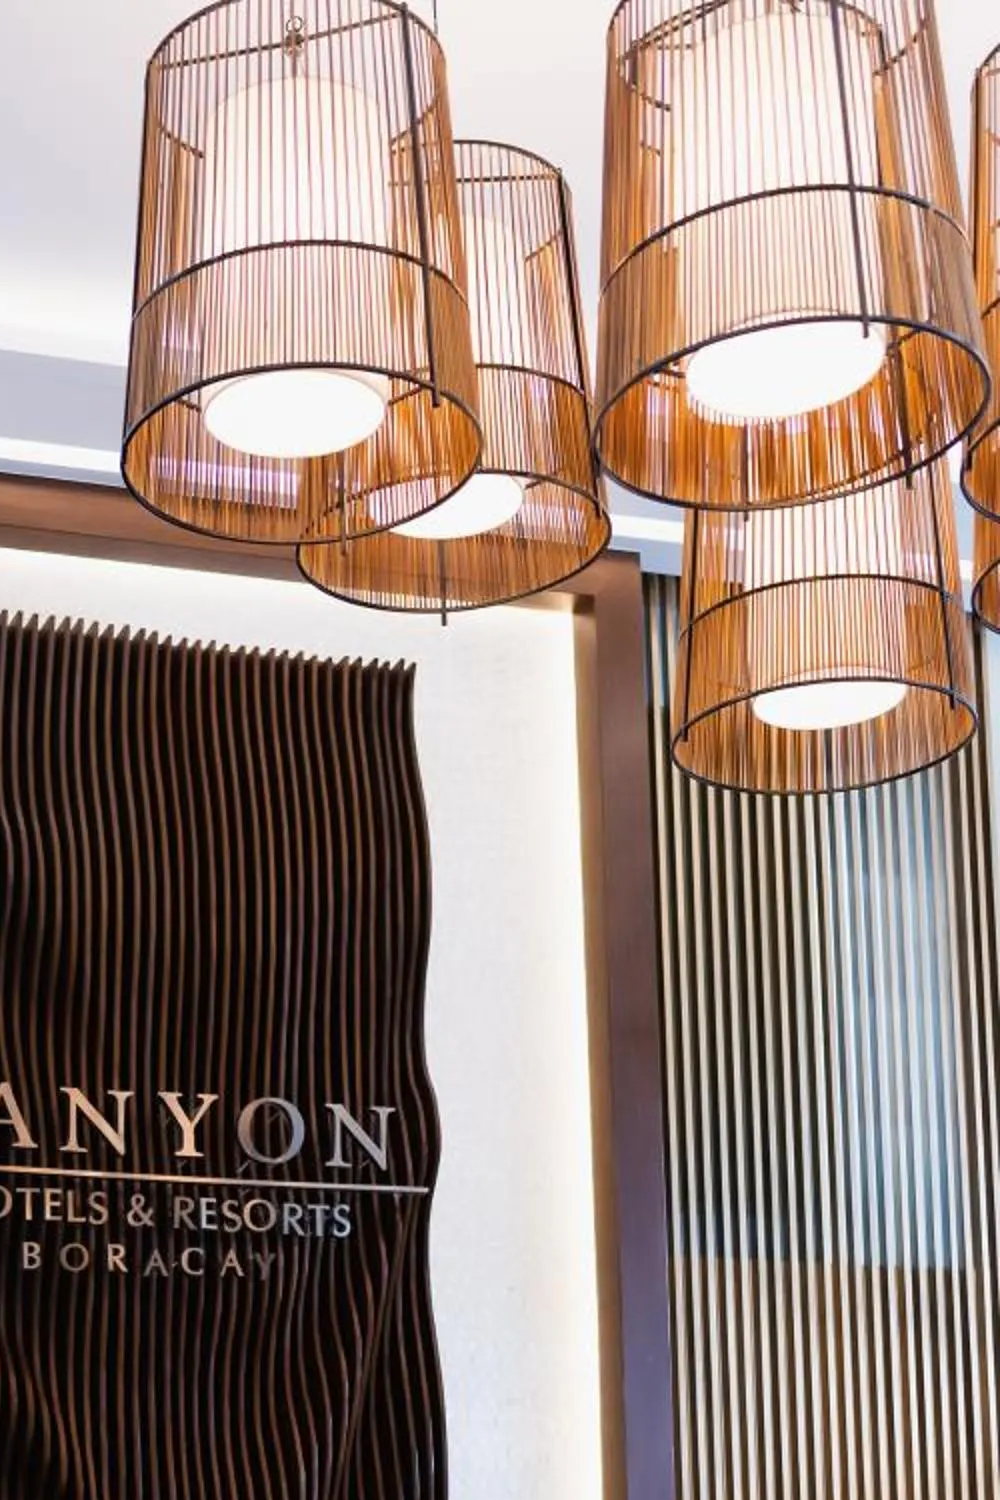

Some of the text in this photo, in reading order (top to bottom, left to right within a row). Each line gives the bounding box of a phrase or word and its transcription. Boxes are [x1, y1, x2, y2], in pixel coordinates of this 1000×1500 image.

[127, 1194, 154, 1228] &
[174, 1197, 352, 1238] RESORTS
[23, 1241, 277, 1280] BORACAY
